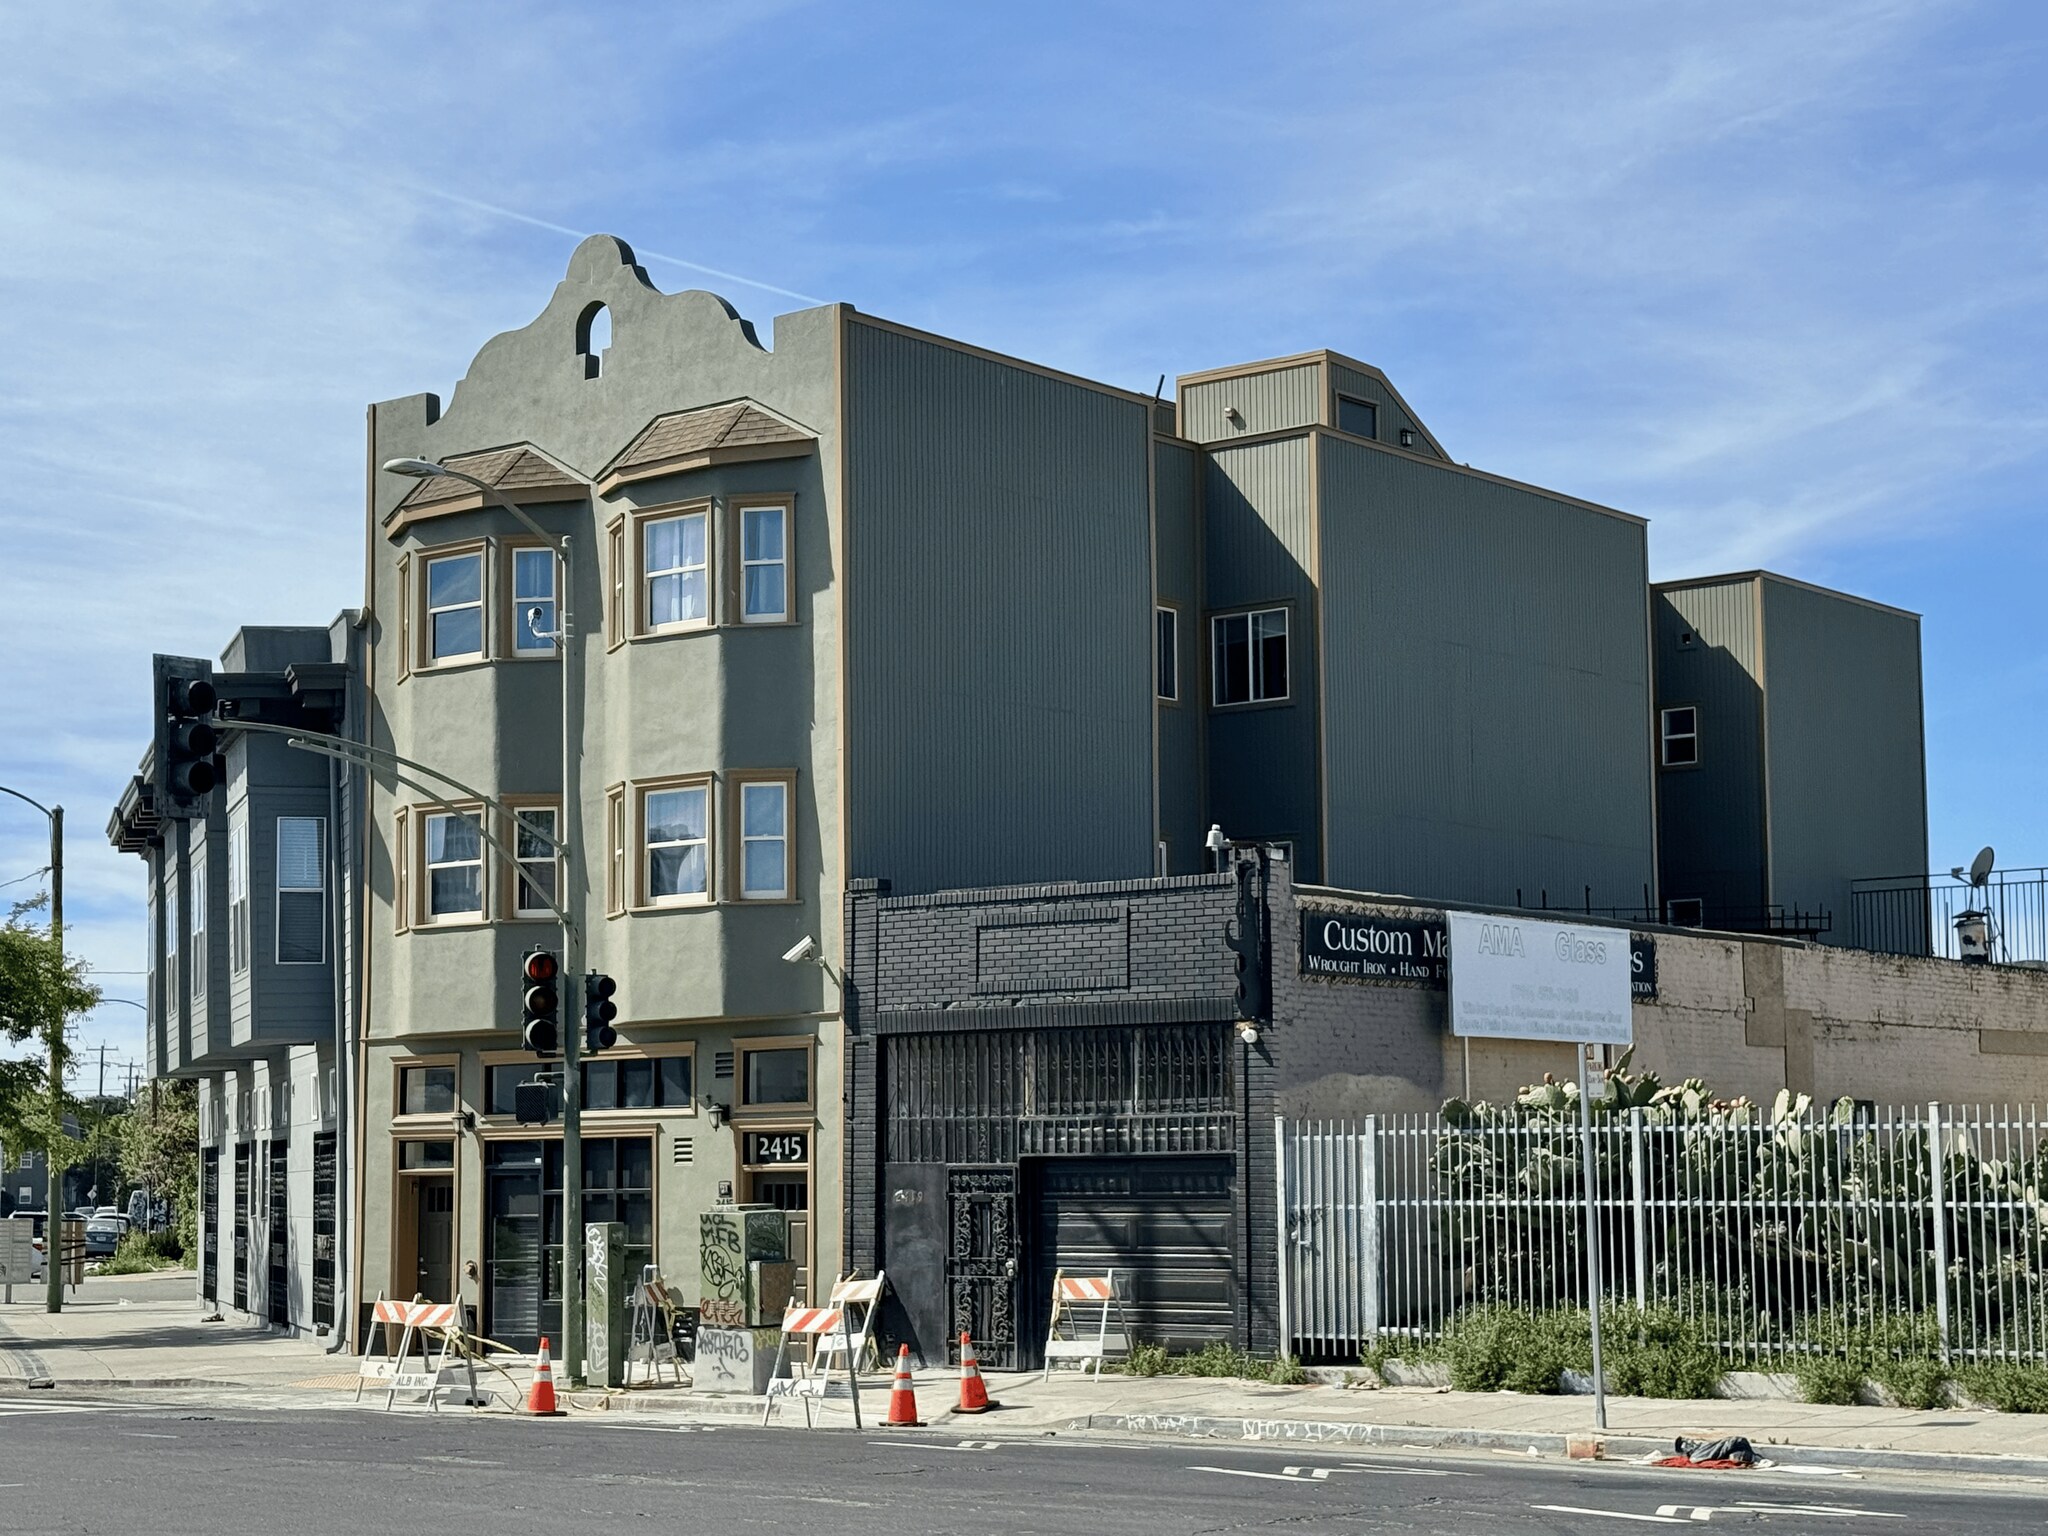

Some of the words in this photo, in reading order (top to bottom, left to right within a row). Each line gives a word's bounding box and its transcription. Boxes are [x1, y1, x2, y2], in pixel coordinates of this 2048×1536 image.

[1323, 920, 1413, 955] Custom
[1477, 922, 1526, 959] AMA
[1554, 930, 1608, 965] Glass
[1308, 954, 1360, 974] WROUGHT
[1363, 958, 1387, 975] IRON
[1400, 961, 1430, 978] HAND
[759, 1136, 802, 1160] 2415
